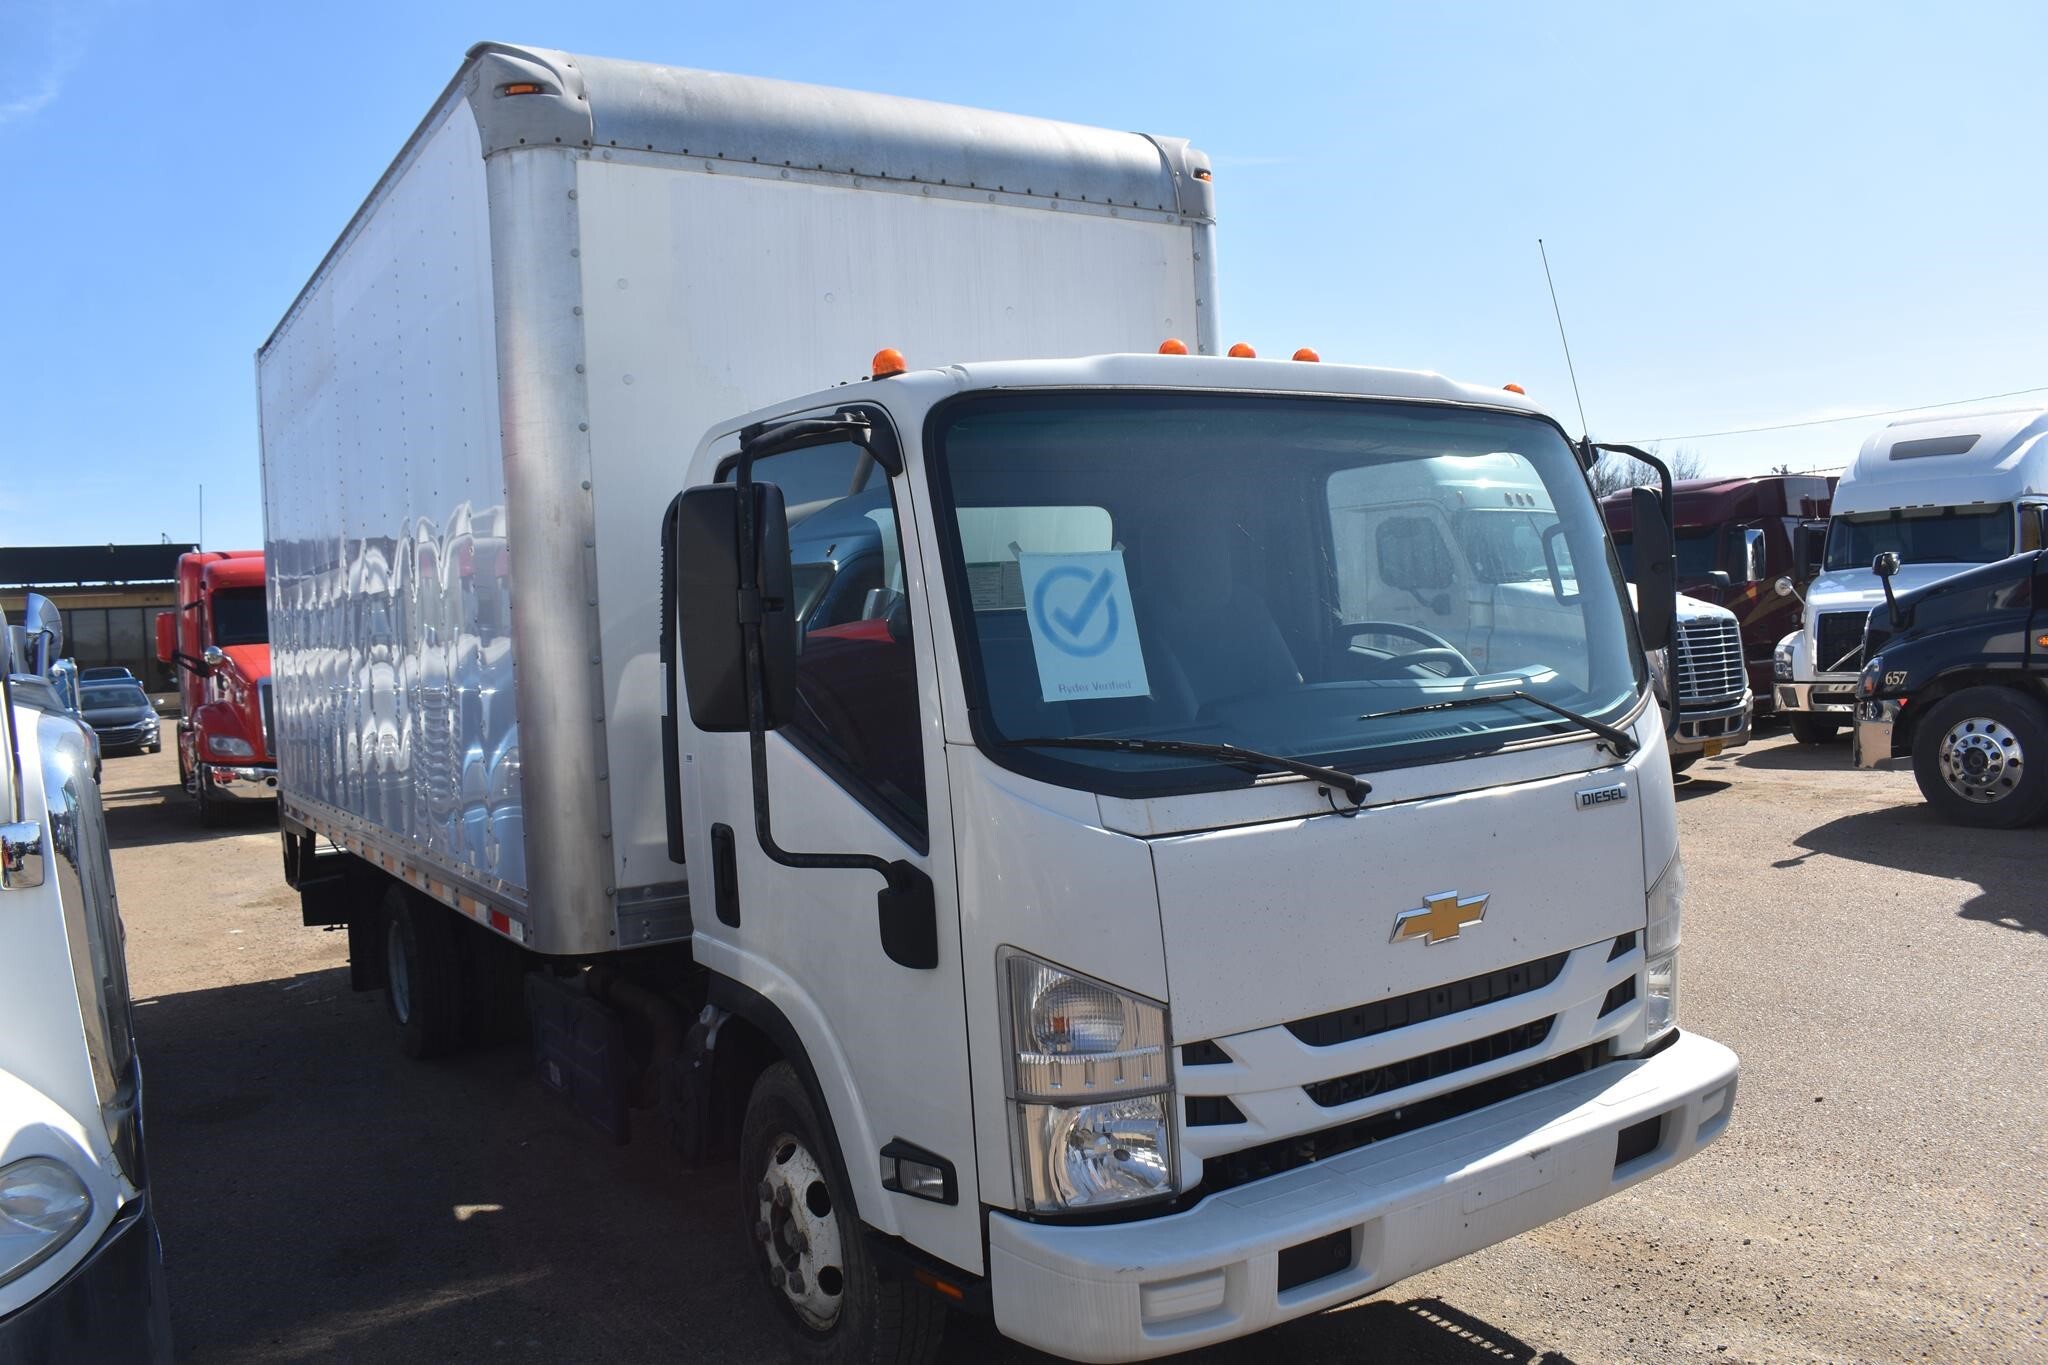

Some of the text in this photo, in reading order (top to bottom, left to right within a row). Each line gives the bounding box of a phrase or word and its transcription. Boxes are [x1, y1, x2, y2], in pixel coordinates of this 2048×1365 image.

[1885, 671, 1908, 685] 657
[1058, 680, 1131, 694] Ryder Verified
[1582, 788, 1626, 805] DIESEL
